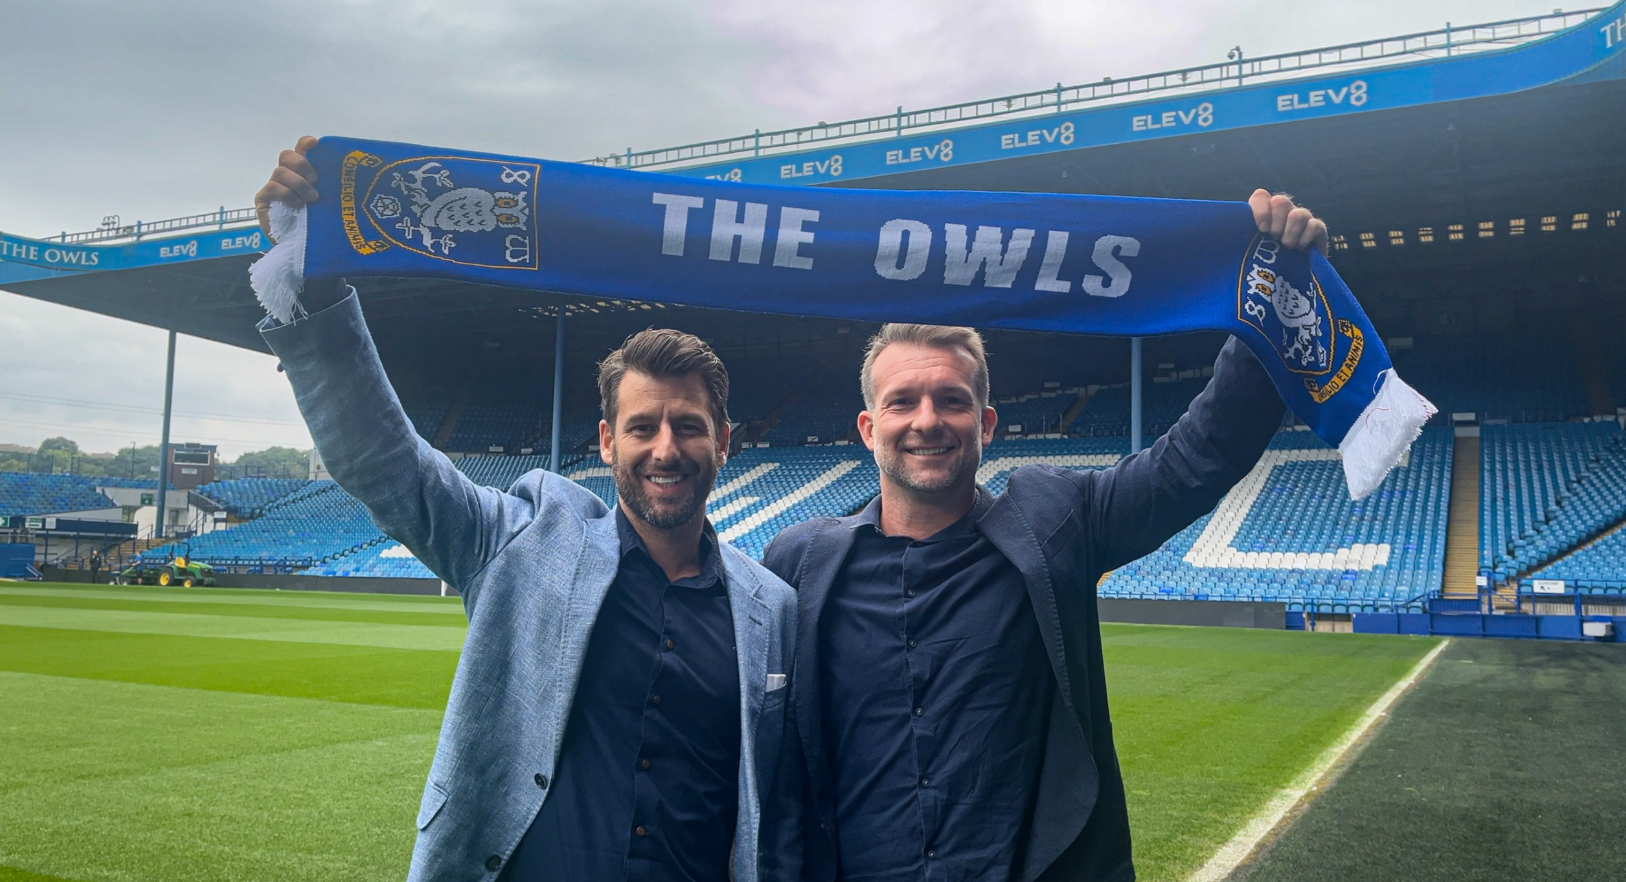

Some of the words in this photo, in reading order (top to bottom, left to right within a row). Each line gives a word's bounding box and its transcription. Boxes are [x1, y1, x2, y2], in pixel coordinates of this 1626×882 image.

[1277, 80, 1367, 112] ELEV8
[1132, 102, 1213, 131] ELEV8
[1001, 121, 1075, 149] ELEV8
[886, 139, 953, 165] ELEV8
[780, 154, 843, 179] ELEV8
[0, 240, 39, 261] THE
[44, 249, 99, 266] OWLS
[159, 240, 198, 258] ELEV8
[221, 231, 261, 250] ELEV8
[652, 192, 820, 270] THE
[873, 218, 1141, 298] OWLS
